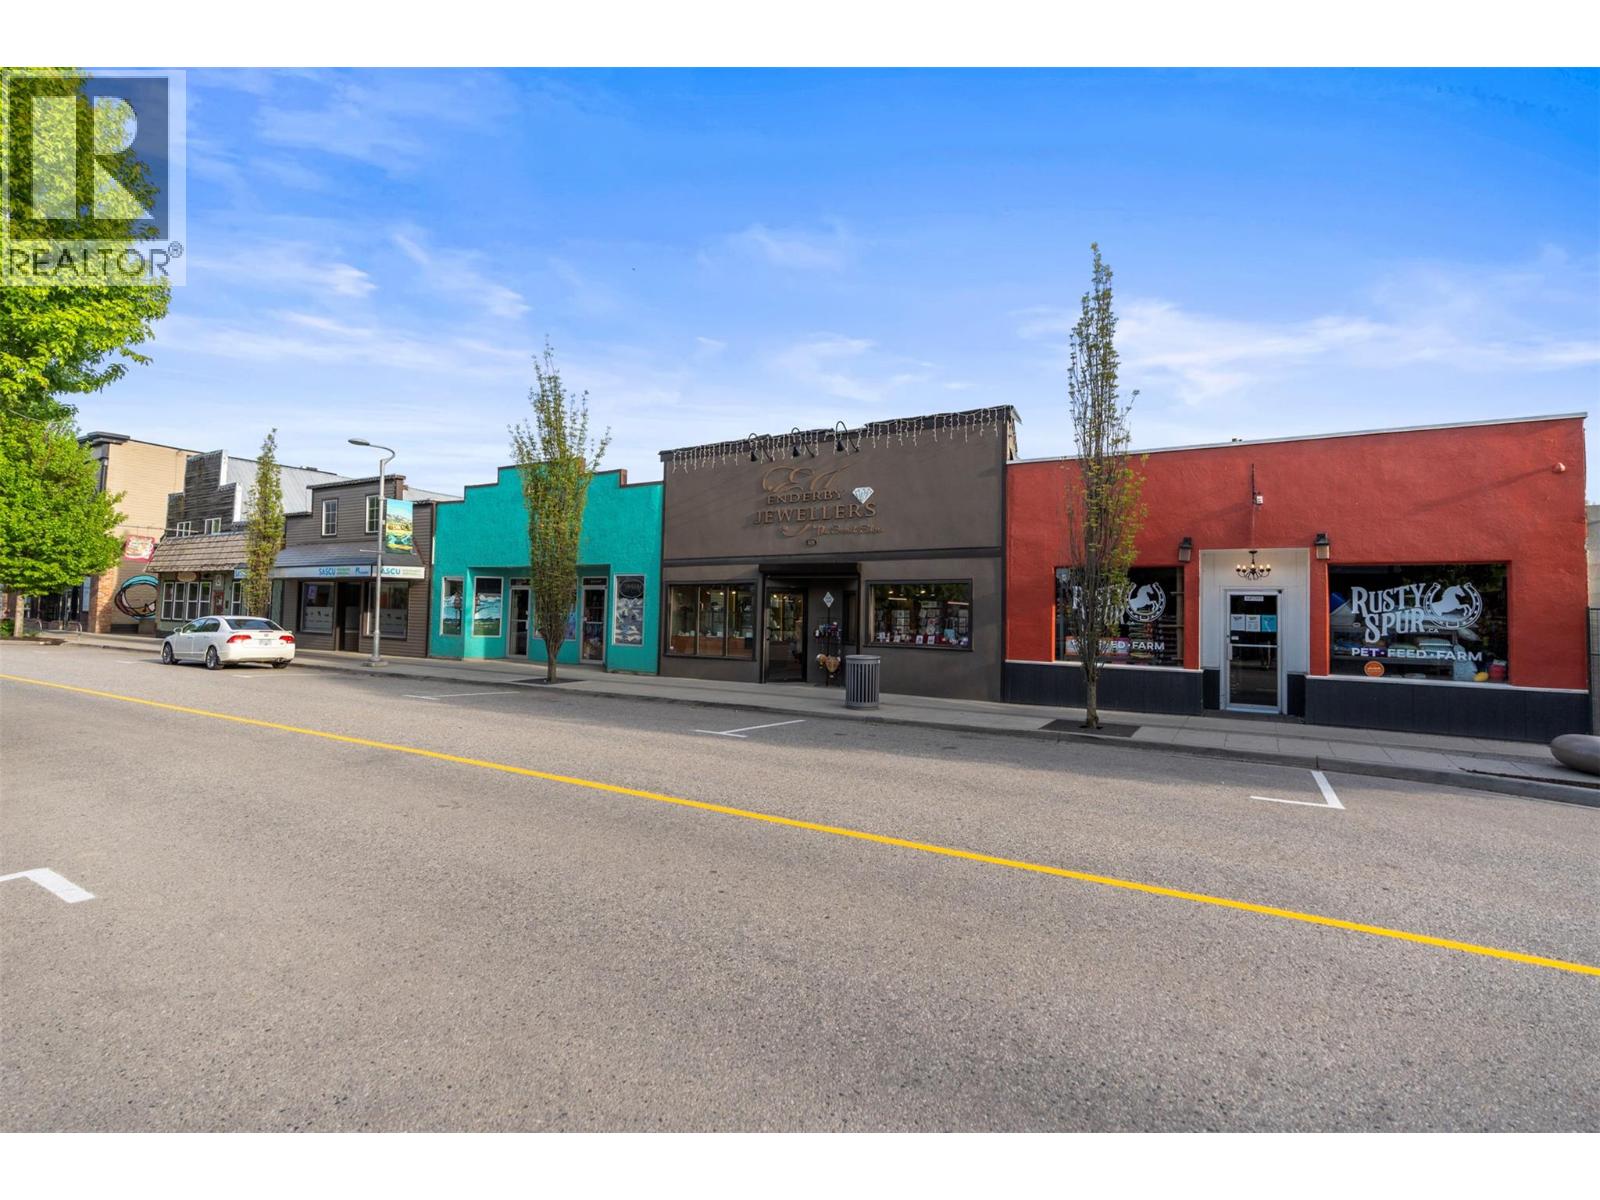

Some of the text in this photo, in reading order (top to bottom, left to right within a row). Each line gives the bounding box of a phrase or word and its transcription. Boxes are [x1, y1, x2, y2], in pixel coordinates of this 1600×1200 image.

[767, 490, 841, 505] ENDERBY
[753, 503, 877, 525] JEWELLERS
[318, 567, 336, 576] SASCU
[1351, 583, 1426, 618] RUSTY
[1365, 607, 1426, 643] SPUR
[1132, 641, 1165, 650] FARM
[1351, 647, 1483, 661] PET FEED FARM
